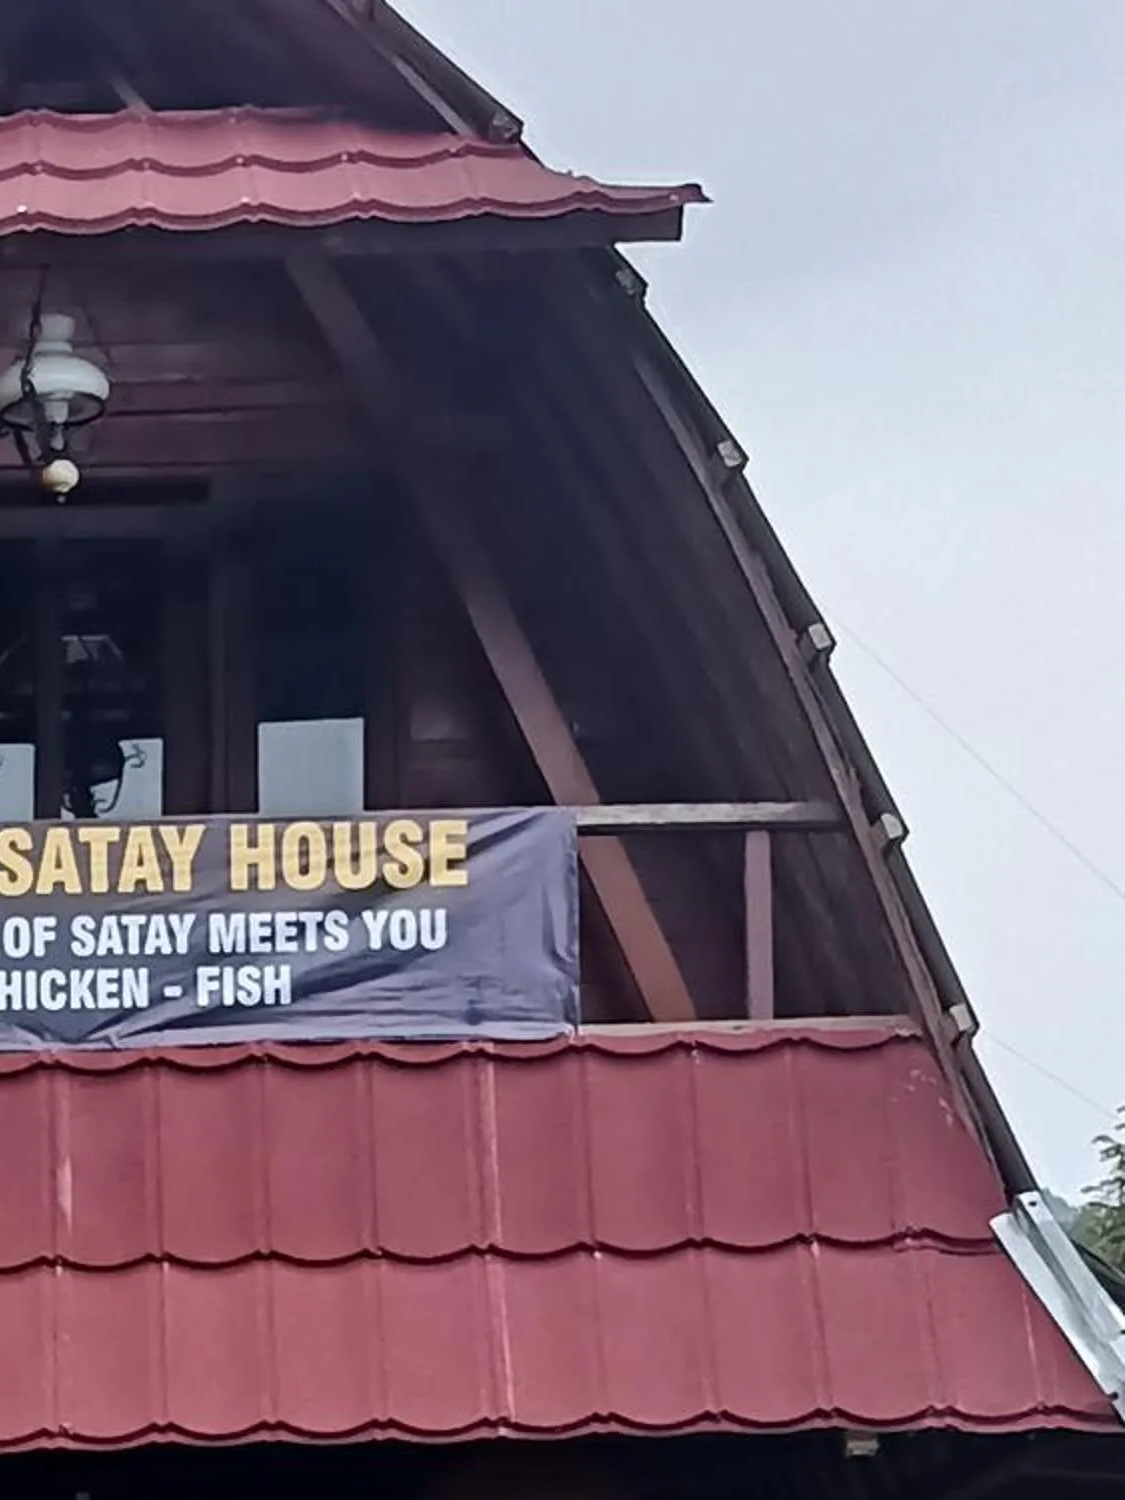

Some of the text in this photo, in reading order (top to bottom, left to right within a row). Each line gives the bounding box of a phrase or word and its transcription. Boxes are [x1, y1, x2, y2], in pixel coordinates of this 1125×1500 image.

[229, 819, 470, 891] HOUSE
[2, 916, 58, 959] OF
[69, 913, 197, 957] SATAY
[208, 910, 351, 954] MEETS
[361, 908, 448, 951] YOU
[195, 964, 293, 1007] FISH
